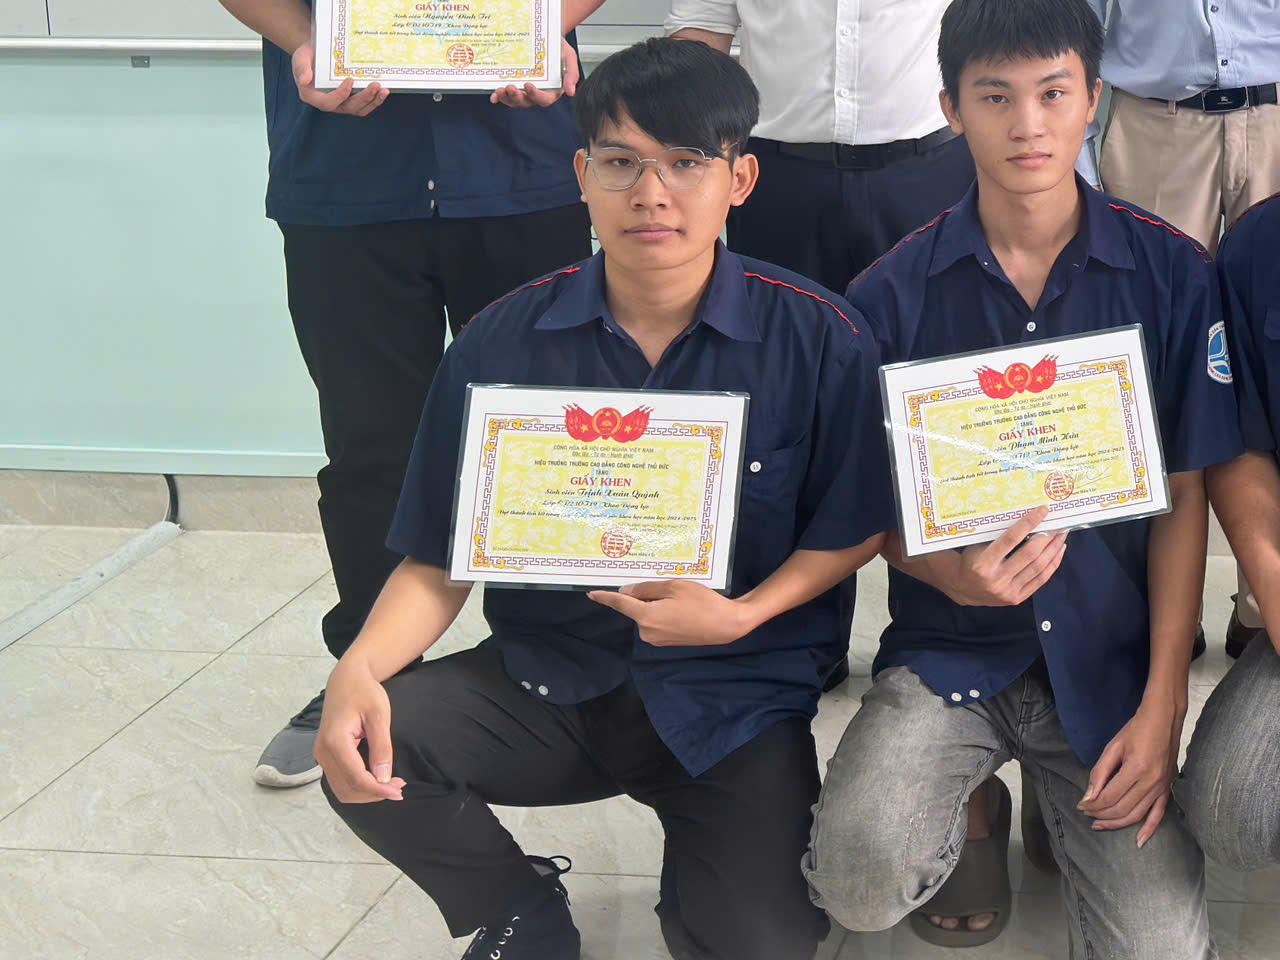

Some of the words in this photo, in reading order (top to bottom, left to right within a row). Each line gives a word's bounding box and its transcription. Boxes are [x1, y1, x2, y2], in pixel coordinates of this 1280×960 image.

[416, 1, 439, 11] GIẤY
[442, 4, 470, 12] KHEN
[999, 426, 1026, 442] GIẤY
[1027, 424, 1057, 438] KHEN
[570, 473, 598, 486] GIẤY
[600, 478, 632, 487] KHEN
